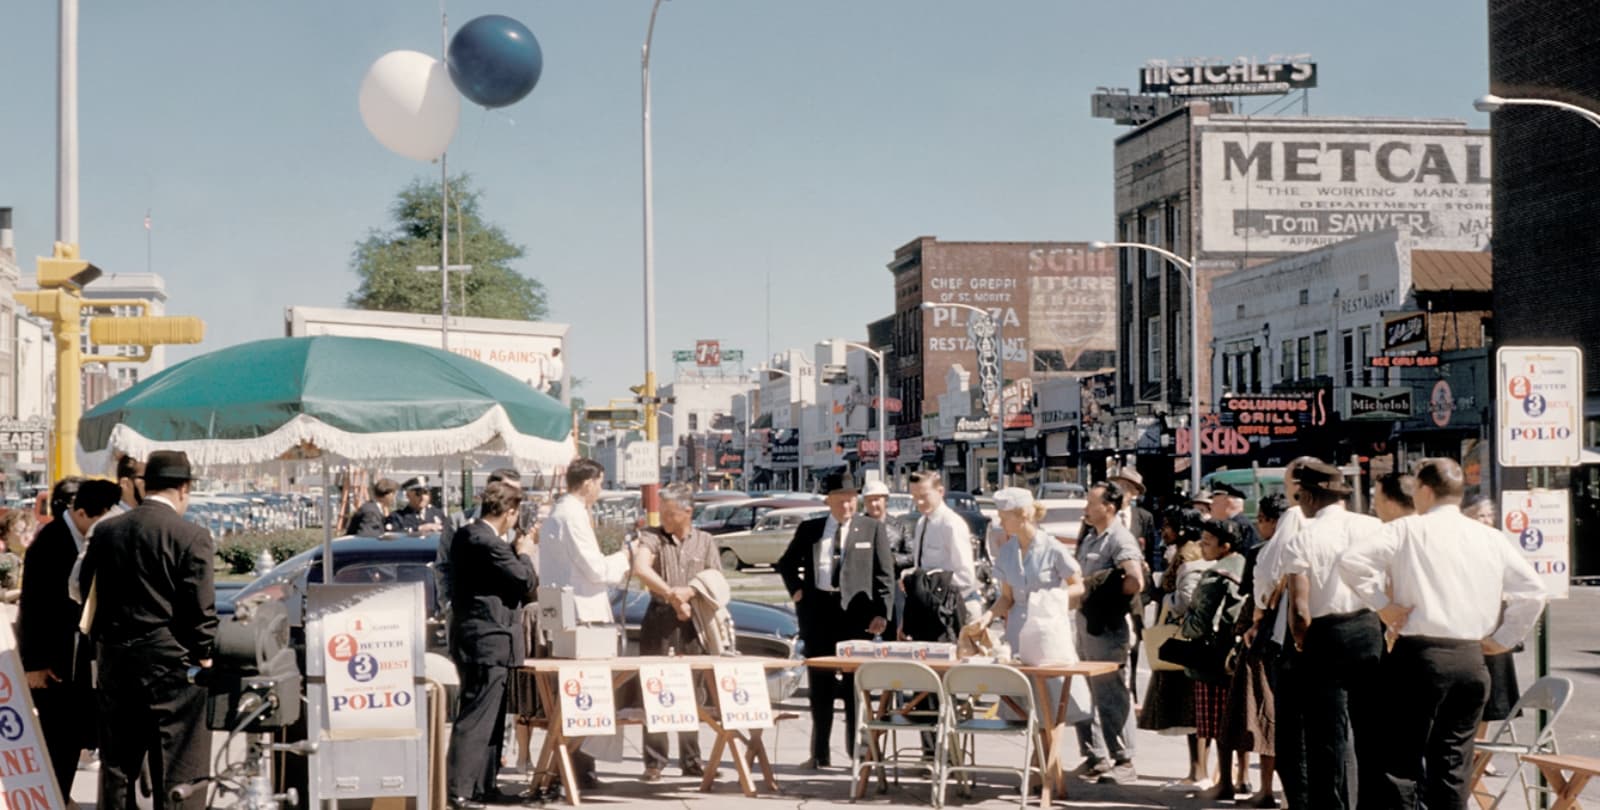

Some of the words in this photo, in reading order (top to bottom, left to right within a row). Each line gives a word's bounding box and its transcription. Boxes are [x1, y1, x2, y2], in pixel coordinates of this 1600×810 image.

[1223, 141, 1491, 184] METCAL
[1317, 187, 1395, 197] WORKING
[1413, 187, 1468, 198] MAN'S
[1300, 201, 1427, 209] DEPARTMENT
[931, 278, 962, 289] CHEF
[970, 278, 1016, 289] GREPPI
[940, 292, 954, 302] OF
[1342, 289, 1395, 313] RESTAURANT
[933, 307, 1020, 327] PLZA
[929, 337, 1025, 350] RESTANT
[1228, 399, 1308, 411] COLUMBUS
[1352, 399, 1409, 411] Michelob
[1239, 412, 1294, 423] GRILL
[1238, 425, 1269, 434] COFFEE
[1274, 425, 1297, 434] SHOP
[1510, 427, 1570, 440] POLIO
[1534, 561, 1566, 575] LIO
[355, 620, 362, 631] 1
[360, 640, 403, 649] BETTER
[380, 660, 408, 670] BEST
[332, 690, 411, 711] POLIO
[651, 714, 695, 724] POLIO
[726, 711, 769, 722] POLIO
[567, 717, 611, 728] POLIO
